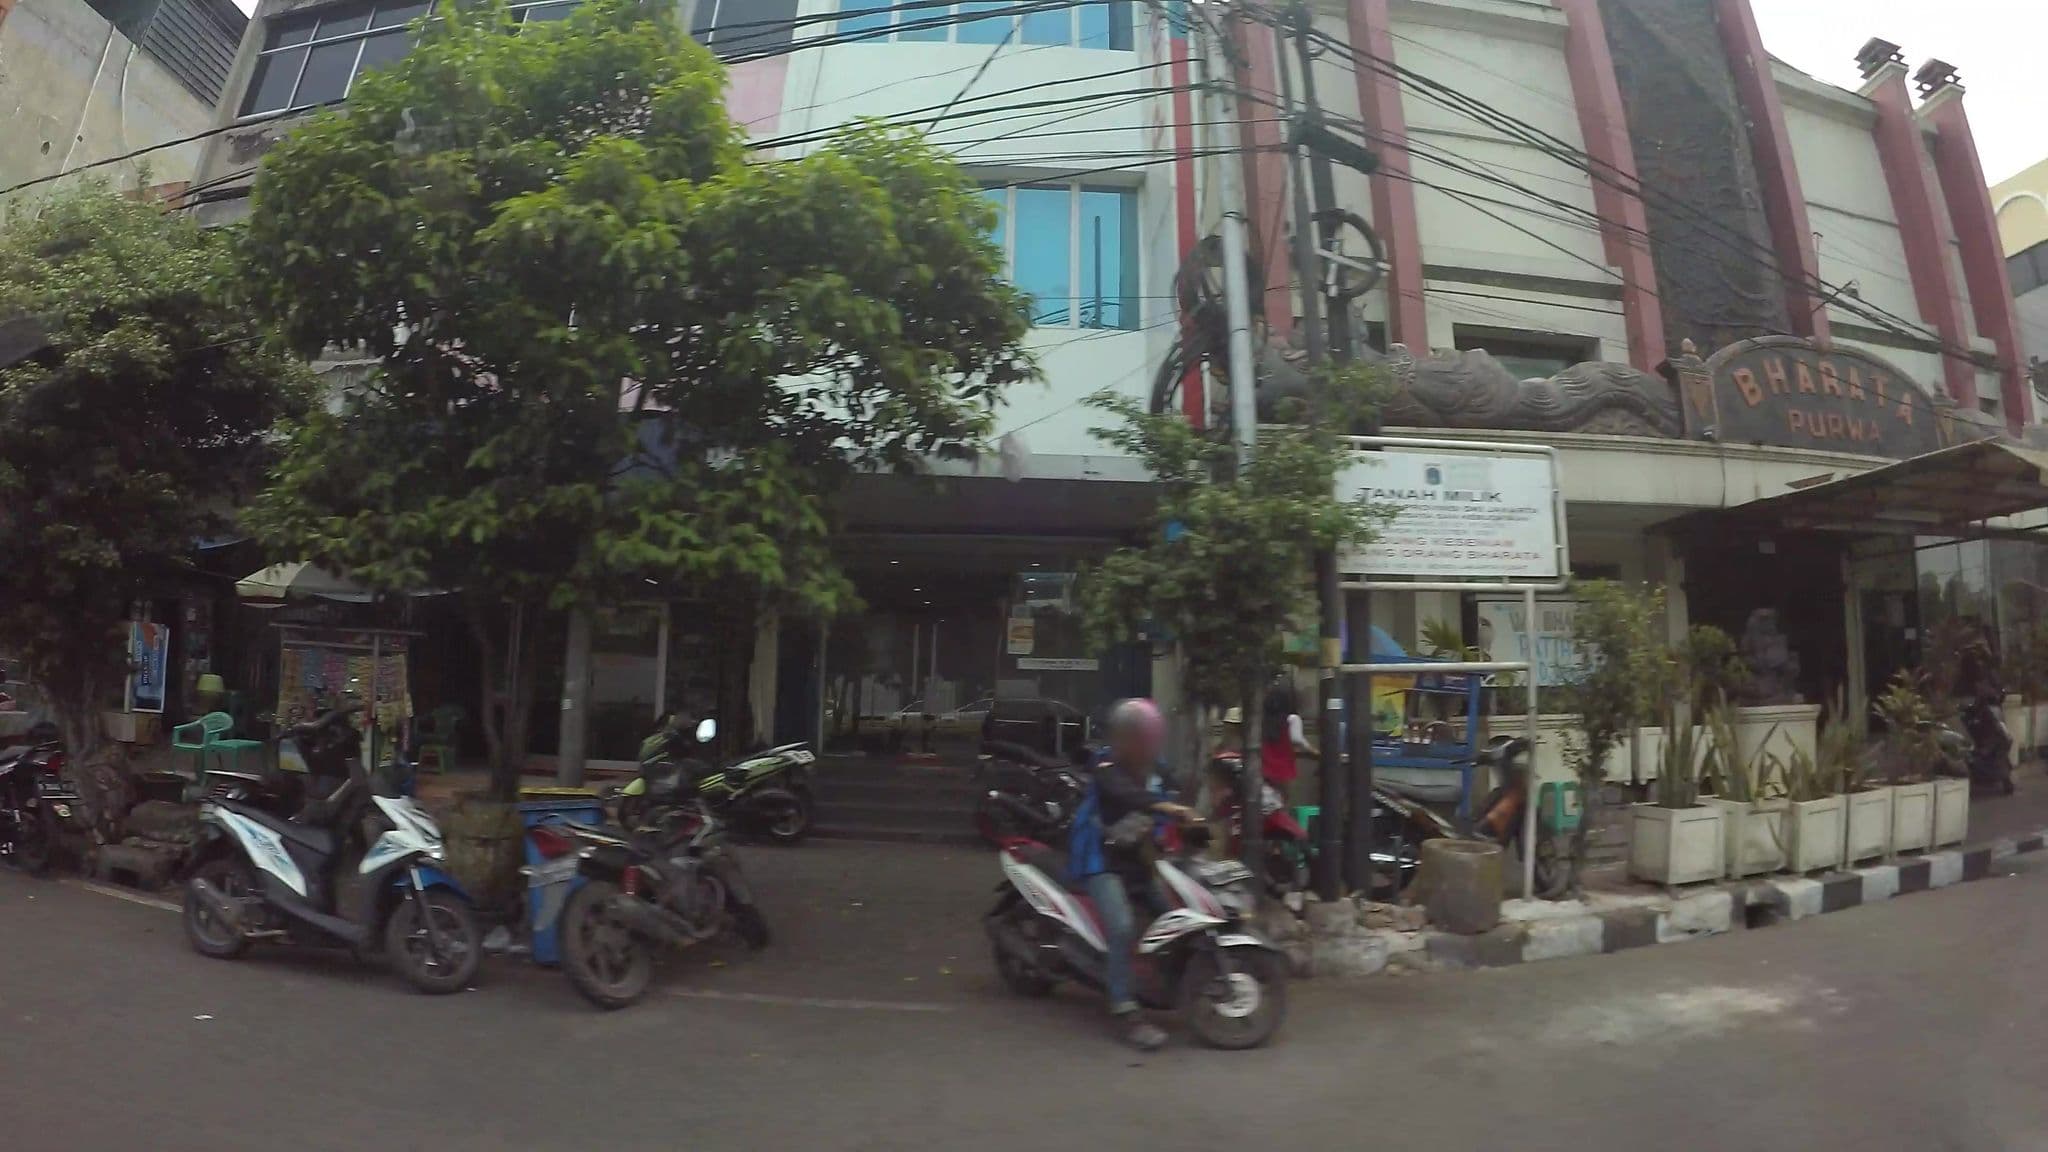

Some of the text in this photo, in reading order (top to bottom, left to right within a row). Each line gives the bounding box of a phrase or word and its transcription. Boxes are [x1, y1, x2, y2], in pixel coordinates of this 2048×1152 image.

[1733, 356, 1914, 426] BHARATA
[1787, 407, 1882, 441] PURWA
[1359, 487, 1503, 503] TANAH MILIK
[1402, 548, 1461, 560] ORANG
[1467, 549, 1541, 560] BHARATA
